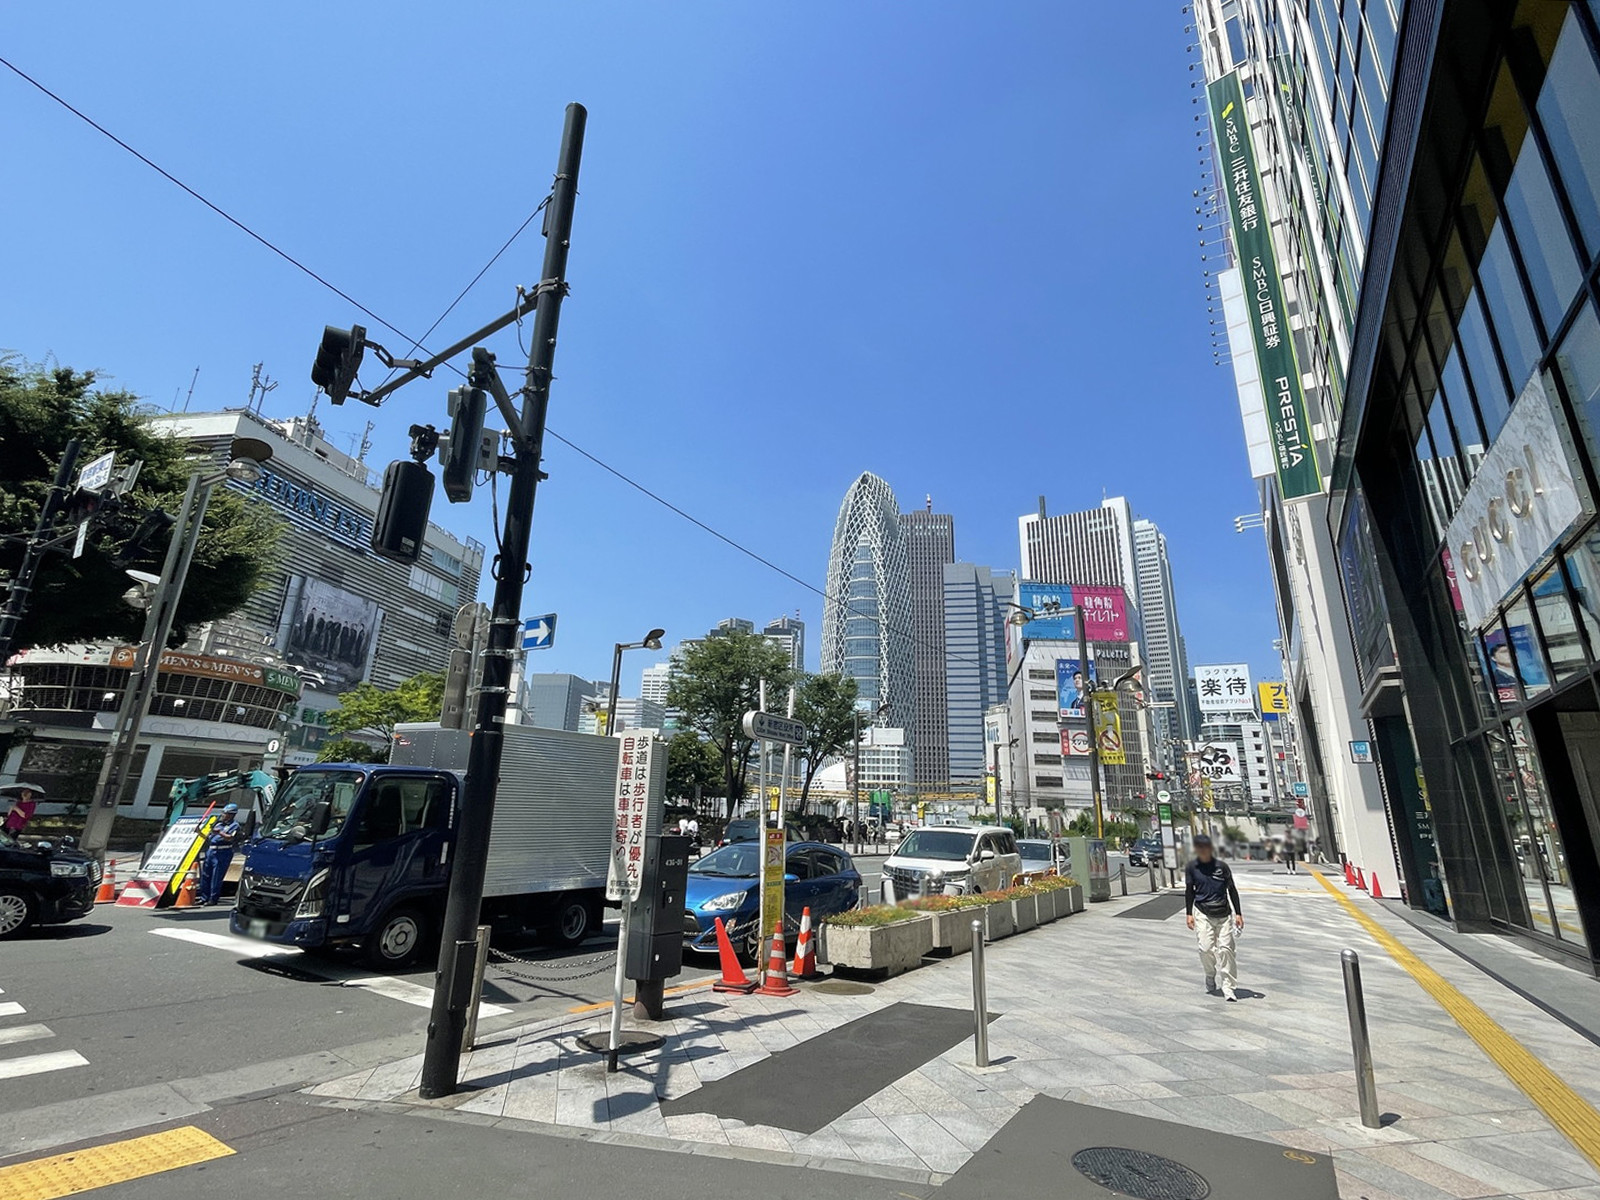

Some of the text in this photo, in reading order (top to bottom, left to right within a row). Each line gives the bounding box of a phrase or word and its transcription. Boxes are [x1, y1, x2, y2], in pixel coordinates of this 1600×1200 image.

[1225, 118, 1258, 231] SMBC 三井住友銀行
[1275, 376, 1305, 467] PRESTIA
[1460, 444, 1543, 583] GUCCI
[212, 661, 252, 678] MEN'S
[1201, 677, 1247, 697] 楽待
[615, 737, 636, 861] 自転車は車道寄り
[626, 736, 650, 879] 歩道は歩行者が優先
